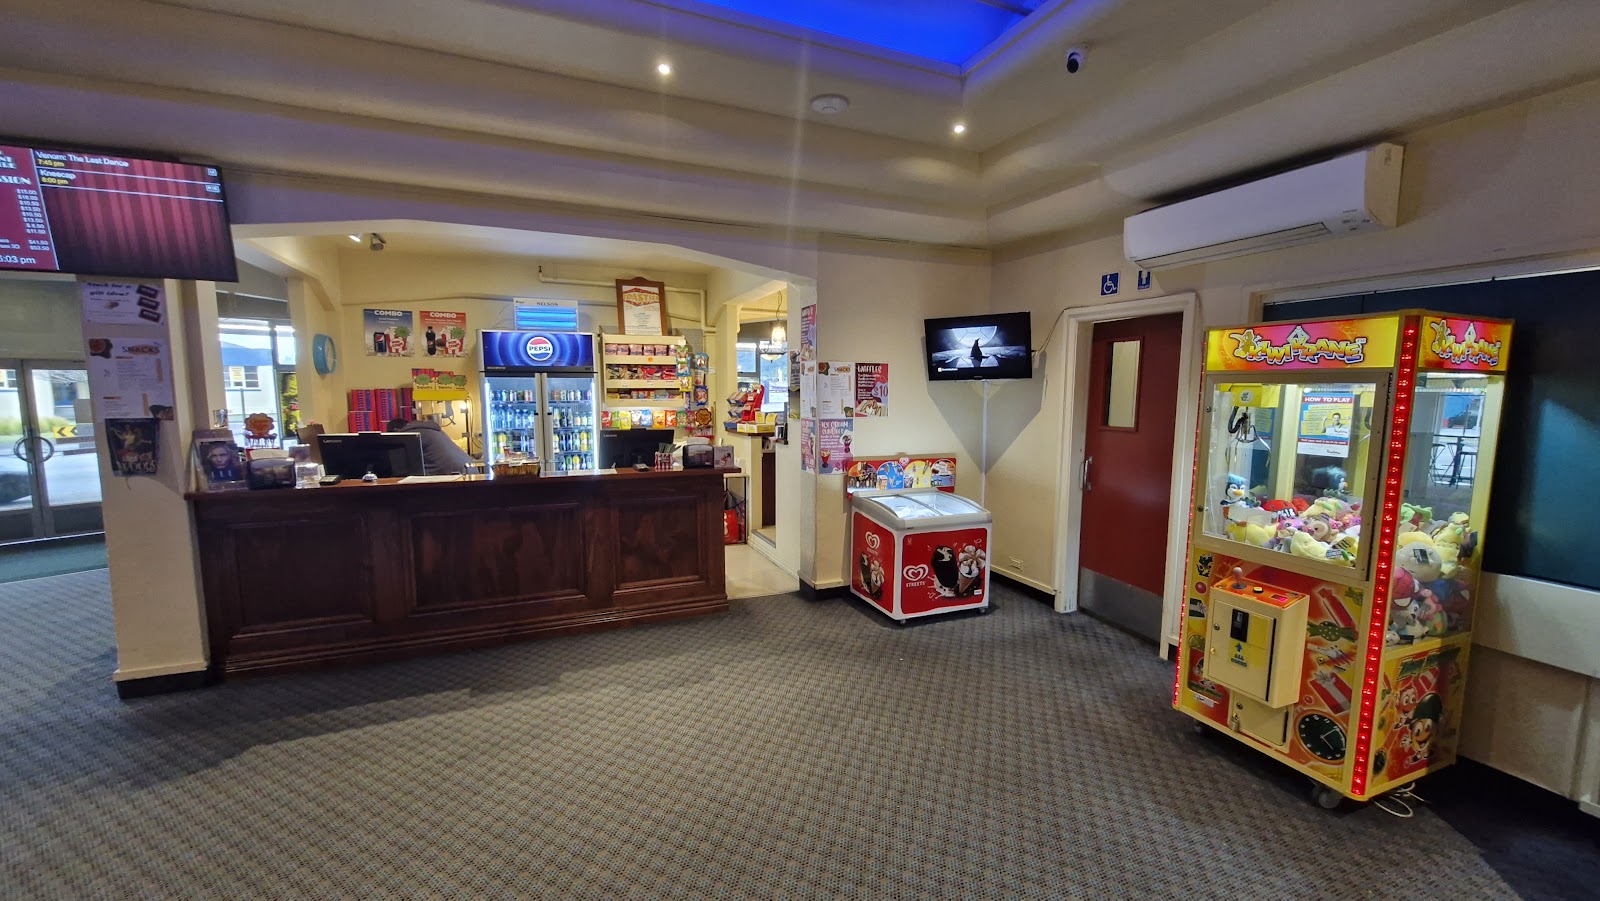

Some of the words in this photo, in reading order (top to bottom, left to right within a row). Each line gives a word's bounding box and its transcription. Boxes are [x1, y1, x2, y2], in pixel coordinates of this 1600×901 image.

[35, 151, 67, 160] Venom:
[68, 154, 84, 163] The
[85, 156, 102, 164] Last
[103, 158, 129, 167] Dance
[40, 169, 76, 180] Kneecap
[873, 384, 889, 397] $10
[821, 421, 830, 429] ICE
[830, 420, 849, 429] CREAM
